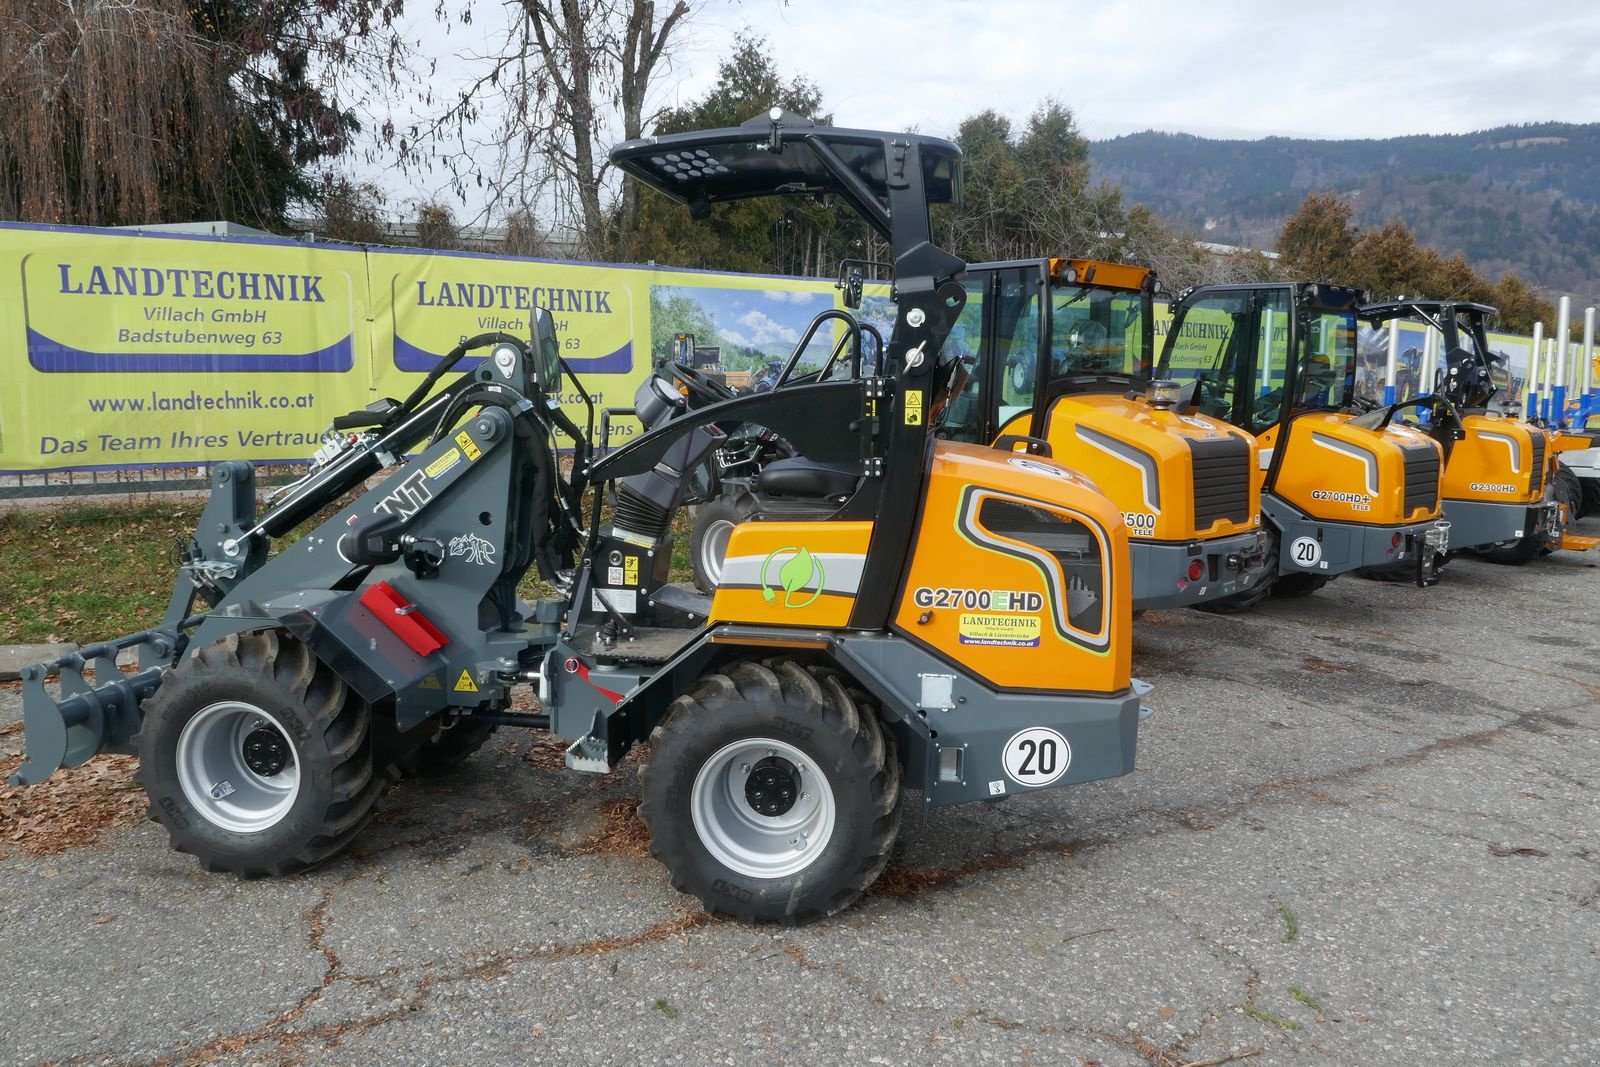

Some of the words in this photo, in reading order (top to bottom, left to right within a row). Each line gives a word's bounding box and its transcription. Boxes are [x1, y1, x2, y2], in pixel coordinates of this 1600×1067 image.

[57, 263, 325, 303] LANDTECHNIK
[416, 280, 613, 314] LANDTECHNIK
[143, 306, 205, 323] Villach
[211, 308, 267, 324] GmbH
[477, 316, 523, 331] Villach
[118, 328, 256, 348] Badstubenweg
[261, 330, 283, 345] 63
[1153, 319, 1230, 340] ANTECHNIK
[565, 338, 580, 350] 63
[89, 390, 314, 412] www.landtechnik.co.at
[40, 435, 88, 455] Das
[98, 433, 161, 451] Team
[171, 431, 228, 449] Ihres
[1470, 482, 1516, 494] G2300HD
[1133, 528, 1154, 536] TELE
[1296, 542, 1315, 562] 20
[963, 616, 1037, 628] LANDTECHNIK
[964, 639, 1034, 647] www.landtechnik.co.at
[1017, 738, 1057, 776] 20
